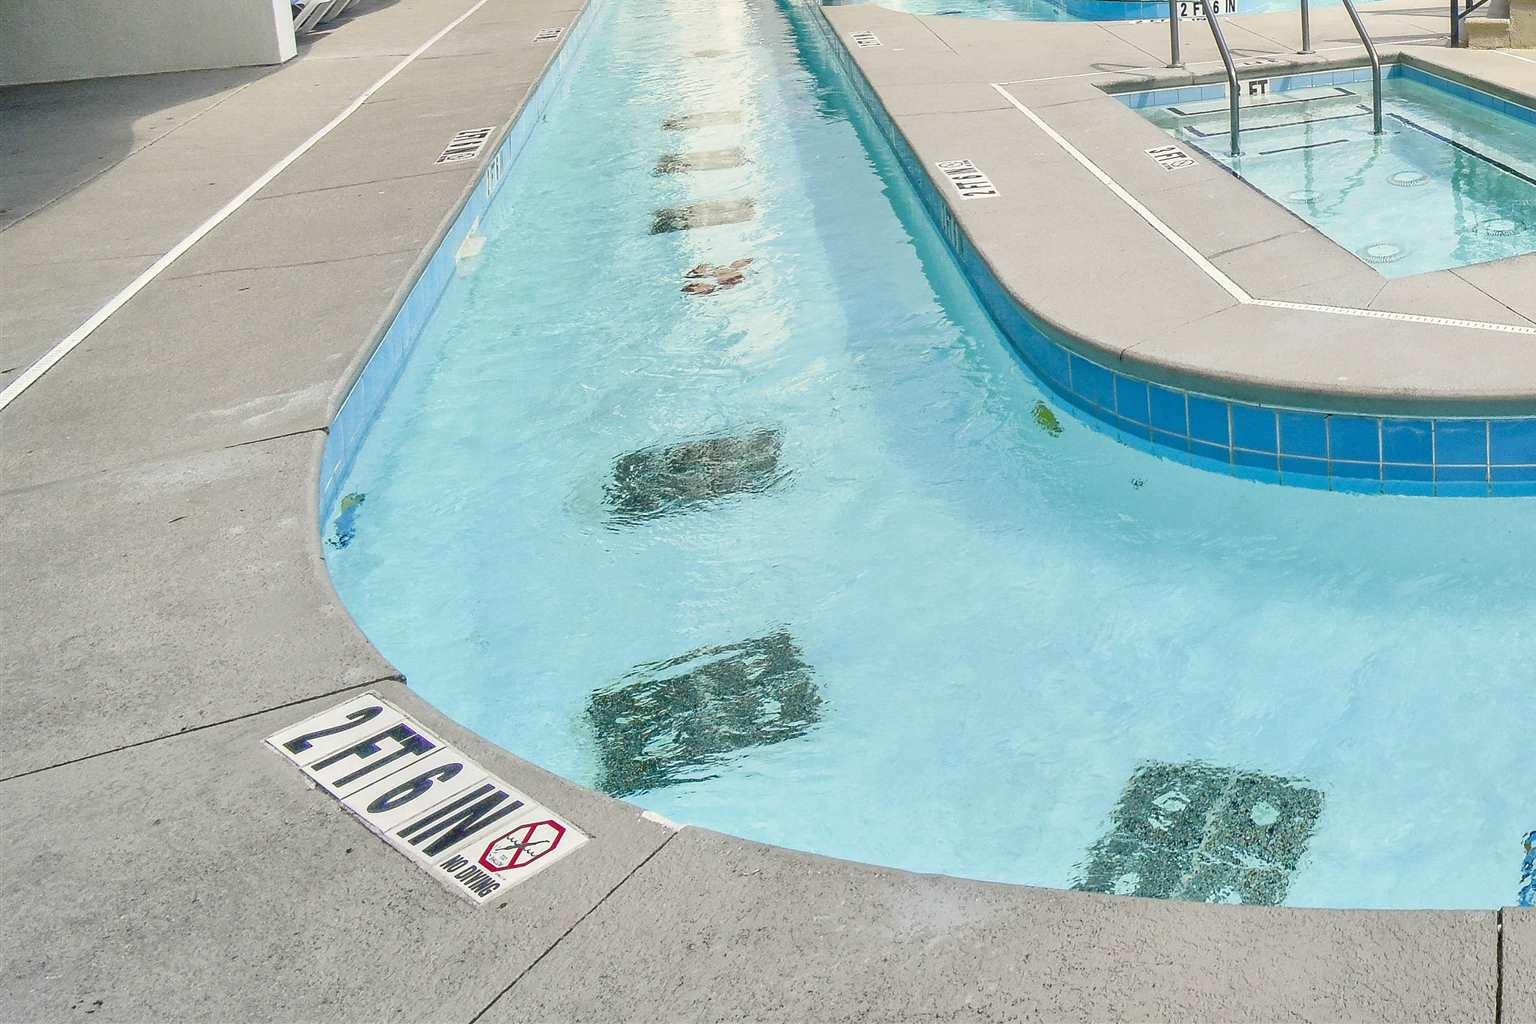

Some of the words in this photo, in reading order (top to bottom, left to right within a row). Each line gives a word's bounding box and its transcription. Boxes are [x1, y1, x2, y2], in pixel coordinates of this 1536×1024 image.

[1180, 2, 1188, 17] 2
[1213, 0, 1220, 14] 6
[1248, 79, 1268, 96] FT
[1154, 151, 1188, 162] FT
[283, 705, 384, 756] 2
[311, 722, 437, 789] FT
[365, 762, 465, 814] 6
[396, 783, 526, 858] IN
[439, 853, 470, 874] NO
[453, 864, 501, 898] DIVING
